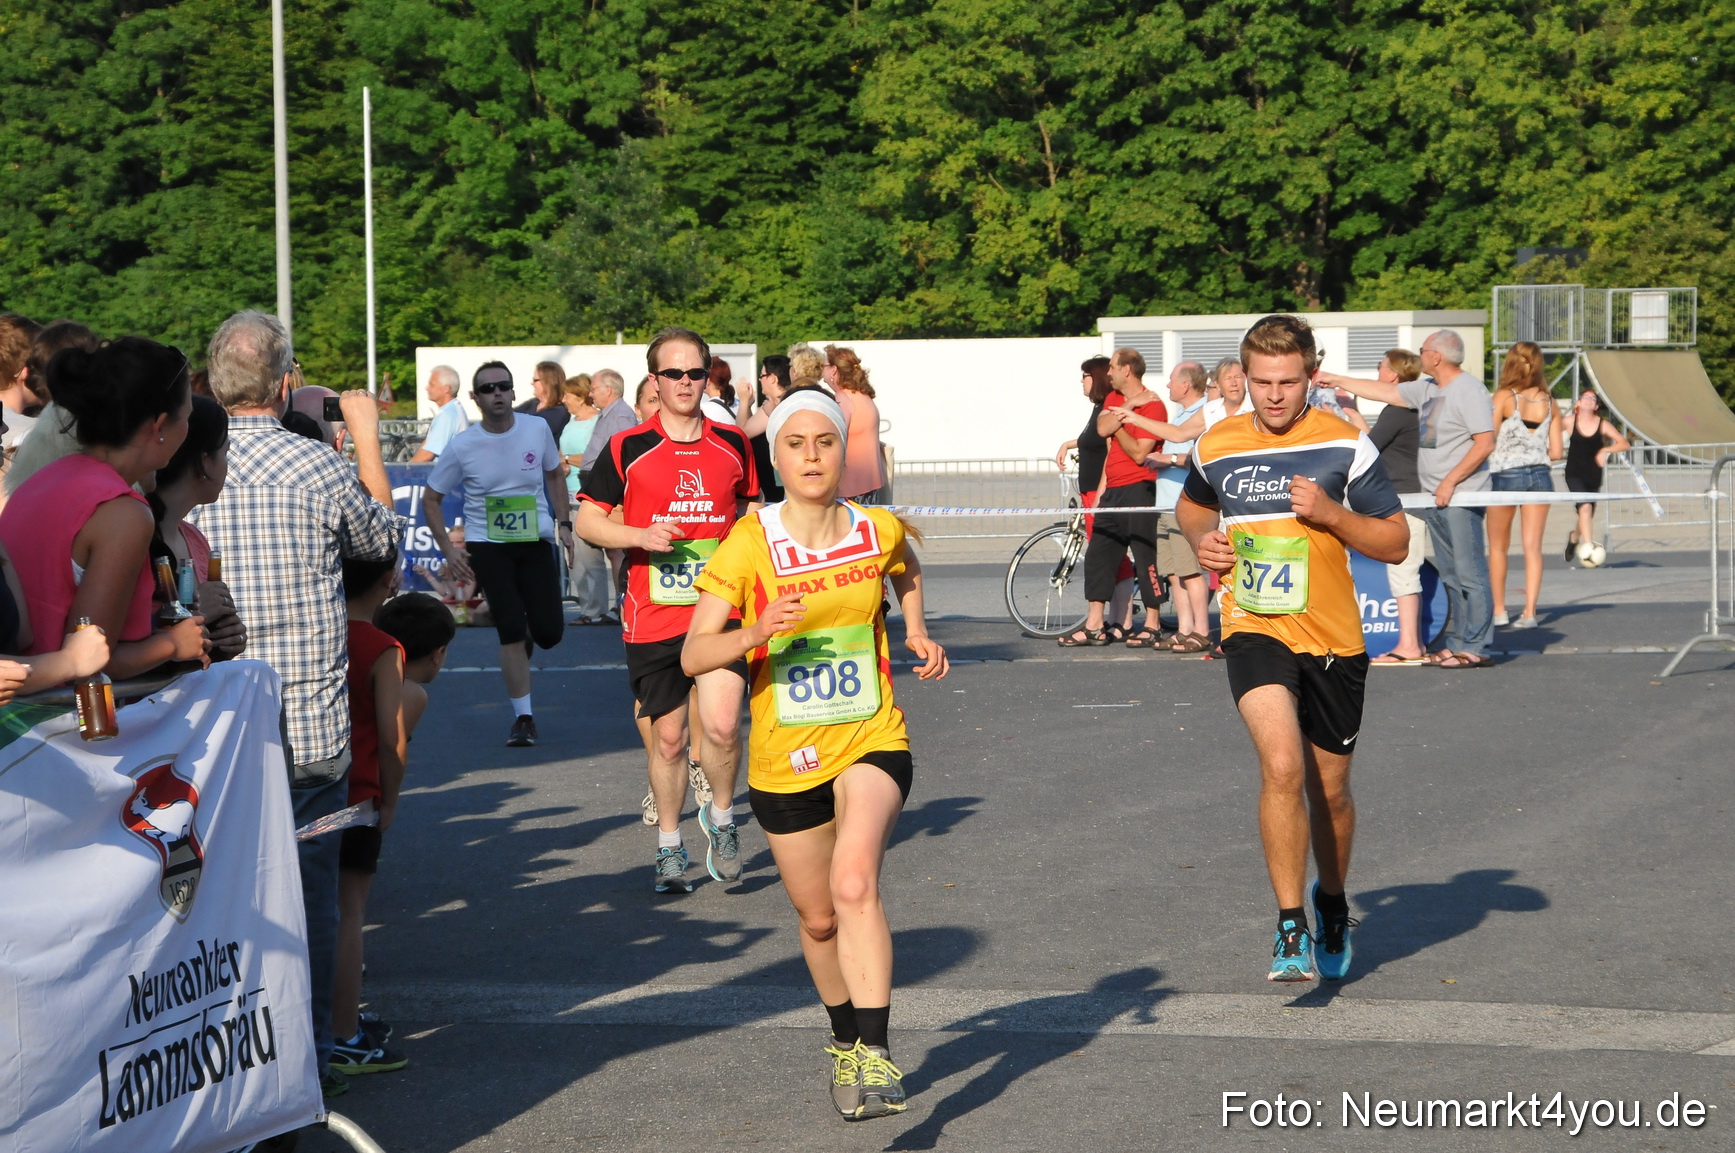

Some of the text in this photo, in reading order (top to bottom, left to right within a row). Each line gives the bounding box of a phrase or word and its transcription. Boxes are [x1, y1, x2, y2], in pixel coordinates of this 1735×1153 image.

[493, 511, 528, 531] 421
[668, 500, 714, 512] MEYER
[701, 568, 737, 591] x-boegl.de
[776, 563, 883, 597] MAX BÖGL
[1242, 559, 1294, 594] 374
[787, 660, 862, 704] 808
[802, 700, 854, 711] Carolin Gottschalk
[125, 937, 242, 1029] Neumarkter
[98, 993, 277, 1130] Lammsbräu
